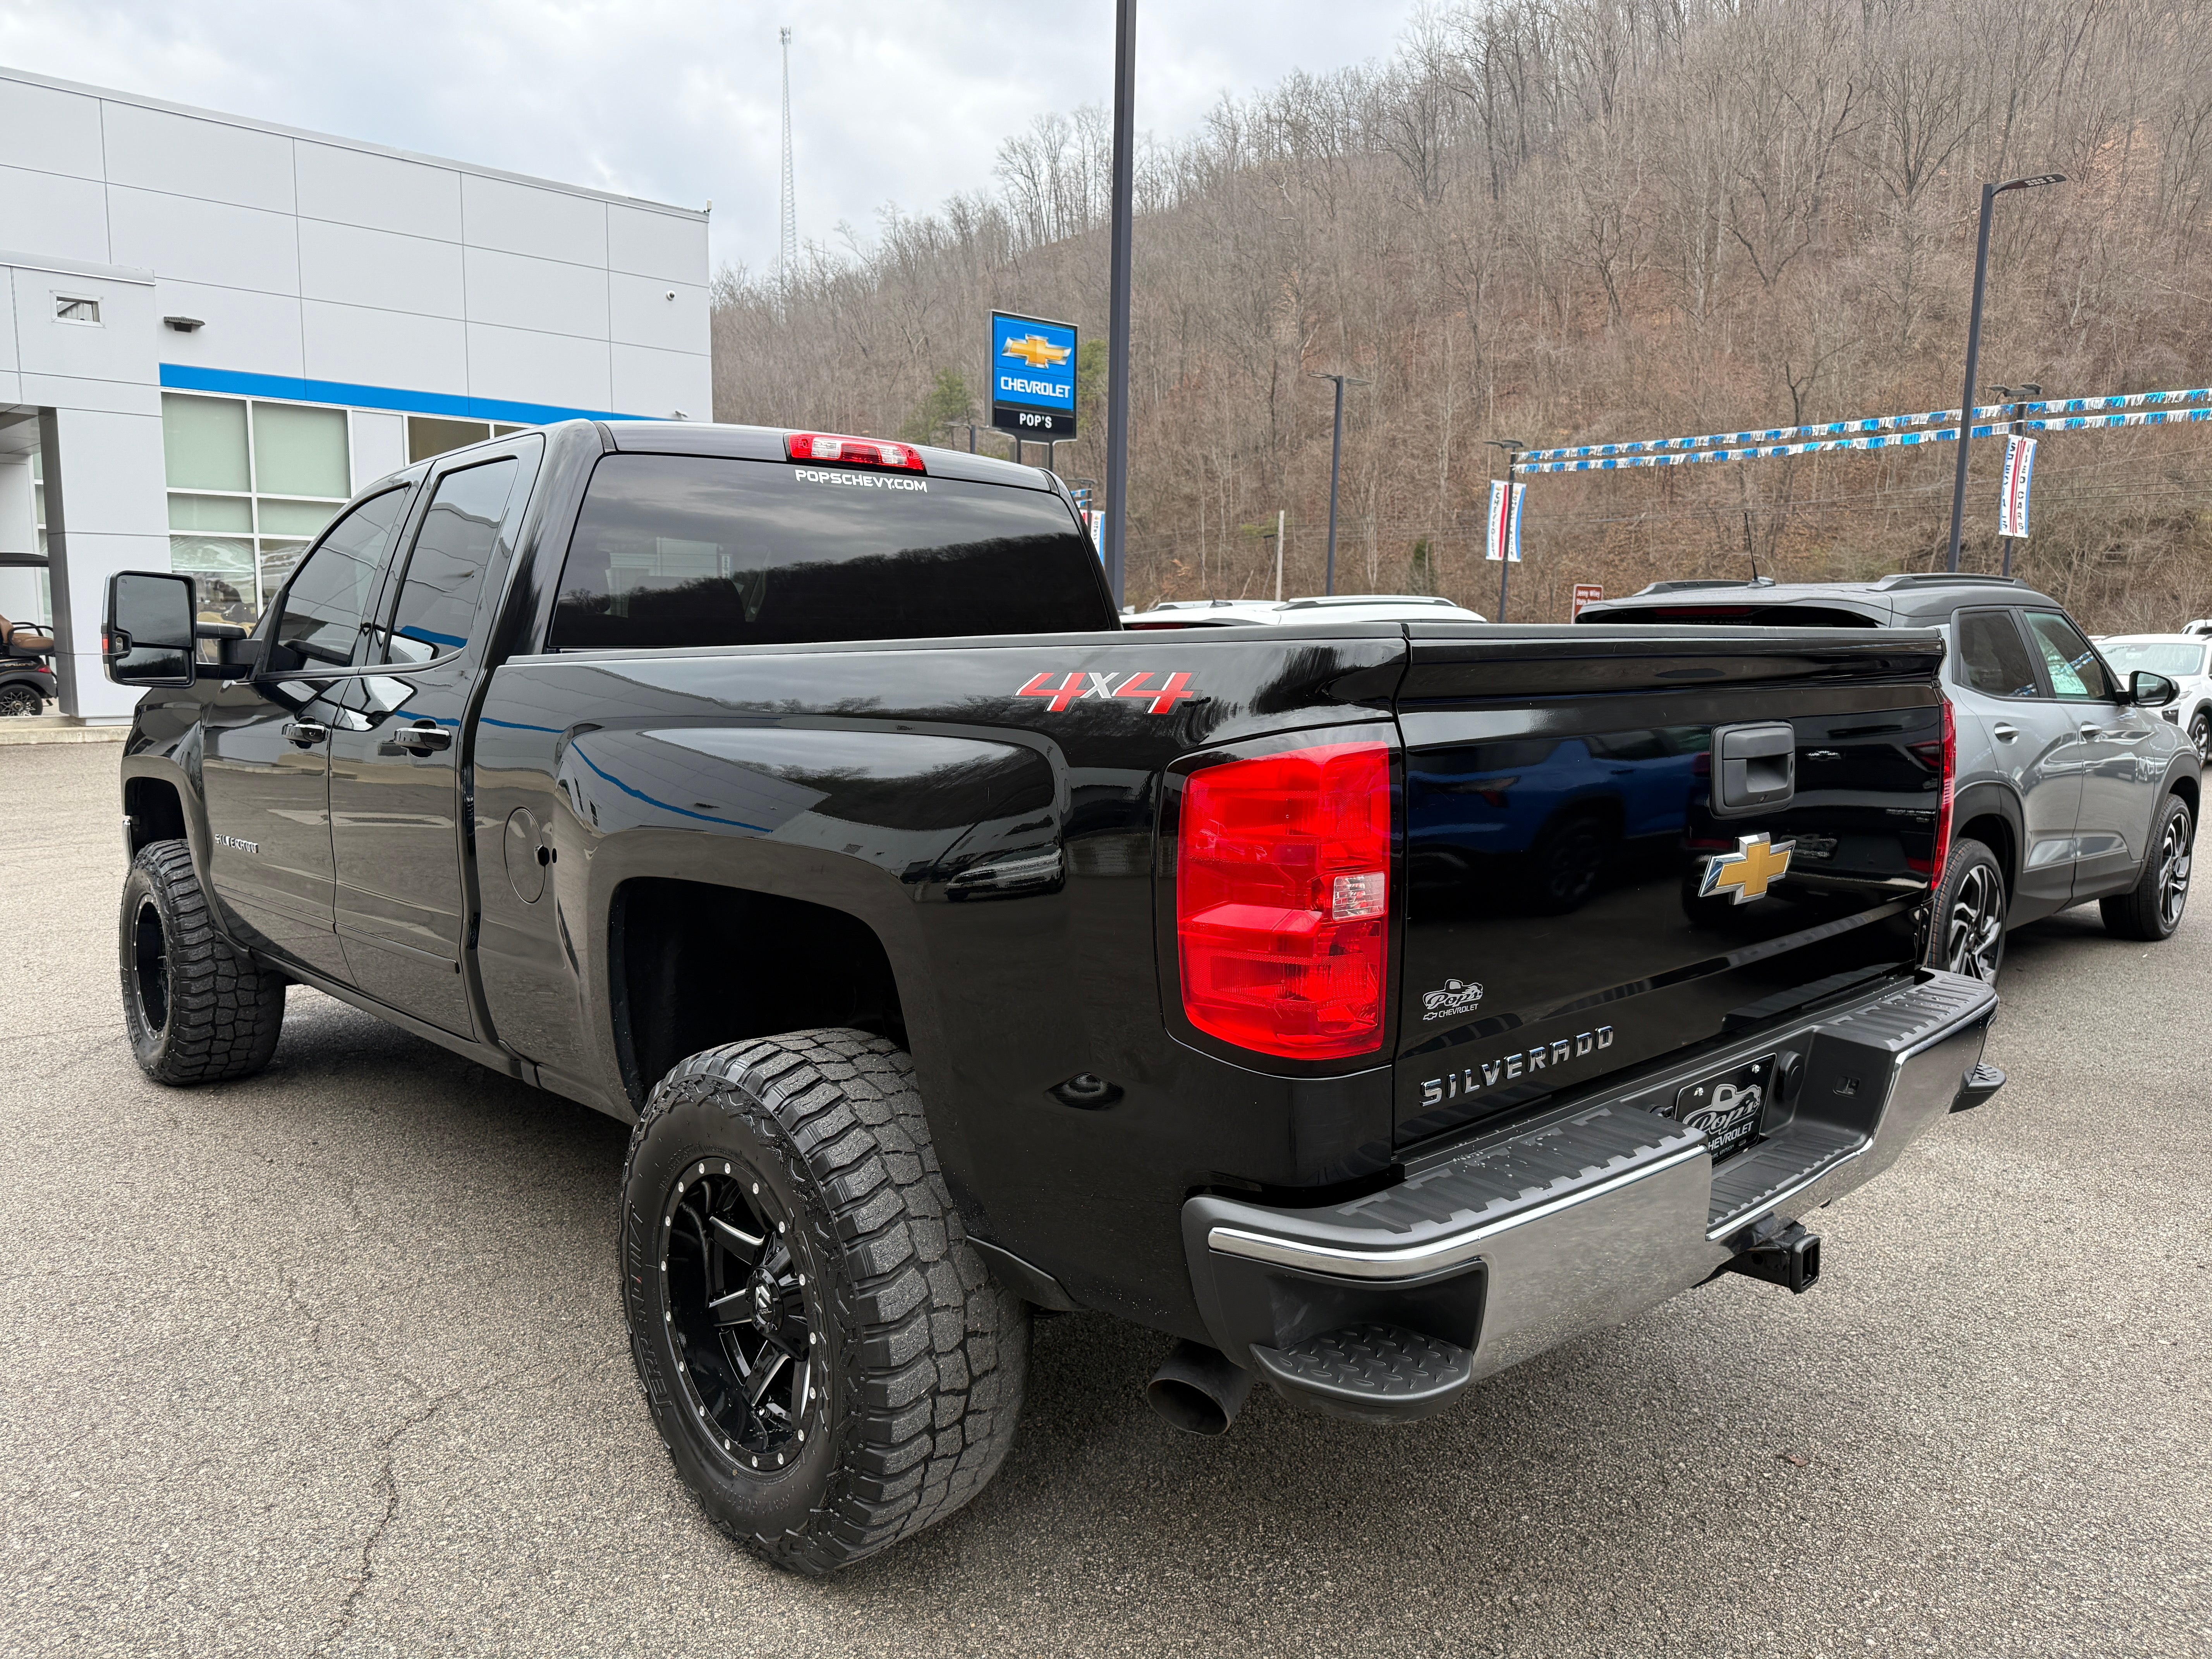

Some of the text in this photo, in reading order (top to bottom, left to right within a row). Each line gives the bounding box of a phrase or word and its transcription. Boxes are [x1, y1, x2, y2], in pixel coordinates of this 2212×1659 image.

[1001, 376, 1071, 398] CHEVROLET
[1019, 412, 1052, 429] POP'S
[795, 469, 927, 493] POPSCHEVY.COM
[215, 834, 259, 853] SILVERADO
[1439, 1003, 1479, 1018] CHEVROLET
[1419, 1025, 1613, 1106] SILVERADO
[1708, 1121, 1754, 1151] HEVROLET
